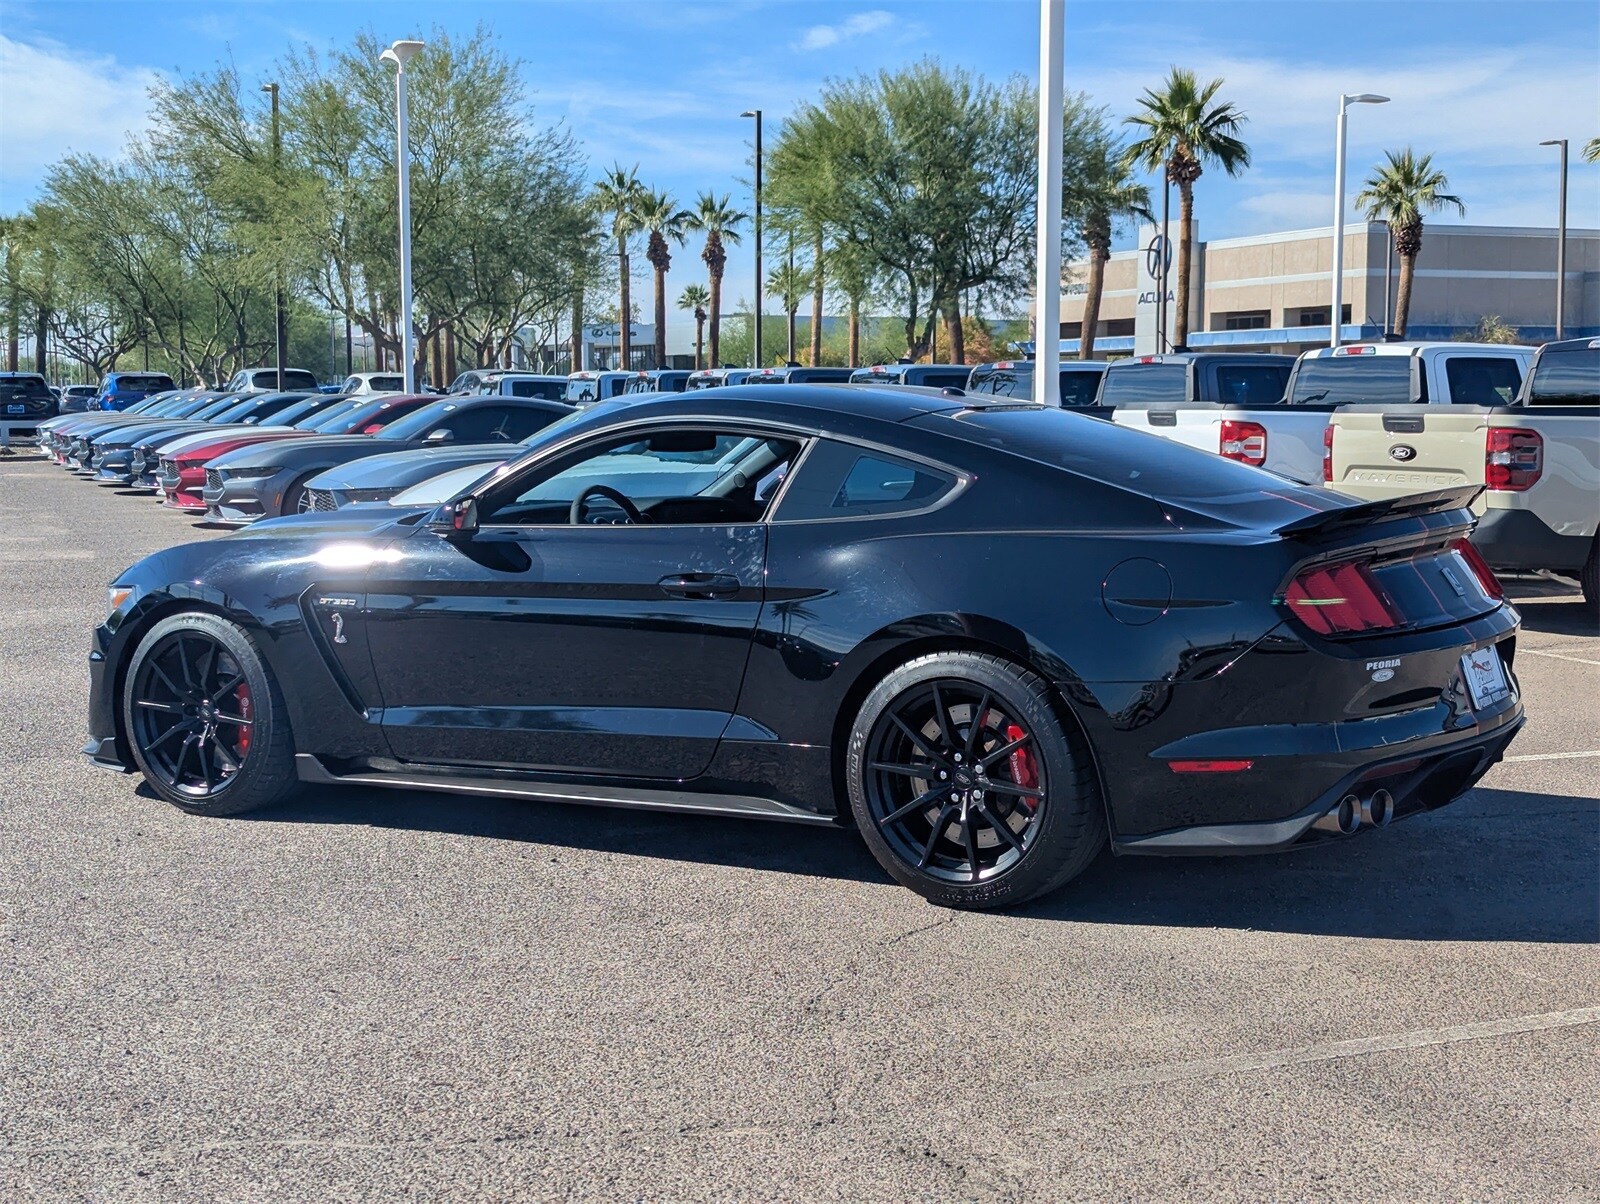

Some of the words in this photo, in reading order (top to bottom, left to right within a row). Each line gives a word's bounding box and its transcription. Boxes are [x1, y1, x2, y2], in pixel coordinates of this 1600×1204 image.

[1138, 290, 1175, 304] ACUA
[1353, 472, 1461, 485] MAVERICK
[1366, 659, 1401, 670] PEORIA
